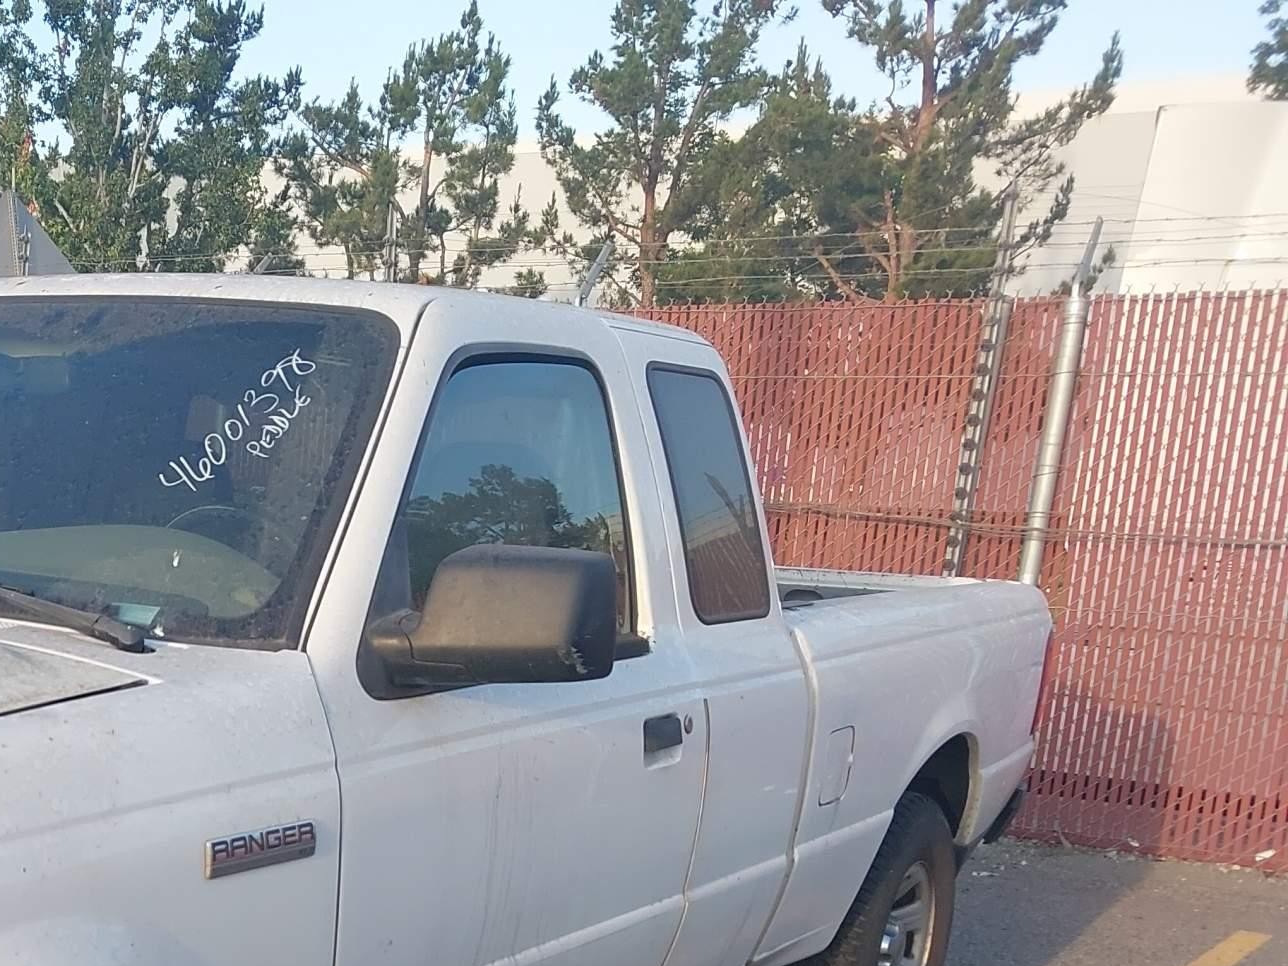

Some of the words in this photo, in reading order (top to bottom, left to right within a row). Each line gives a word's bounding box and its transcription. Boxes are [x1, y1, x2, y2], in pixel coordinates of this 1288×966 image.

[158, 347, 316, 492] 46001398
[246, 384, 312, 458] PEDDLE
[211, 822, 315, 862] RANGER
